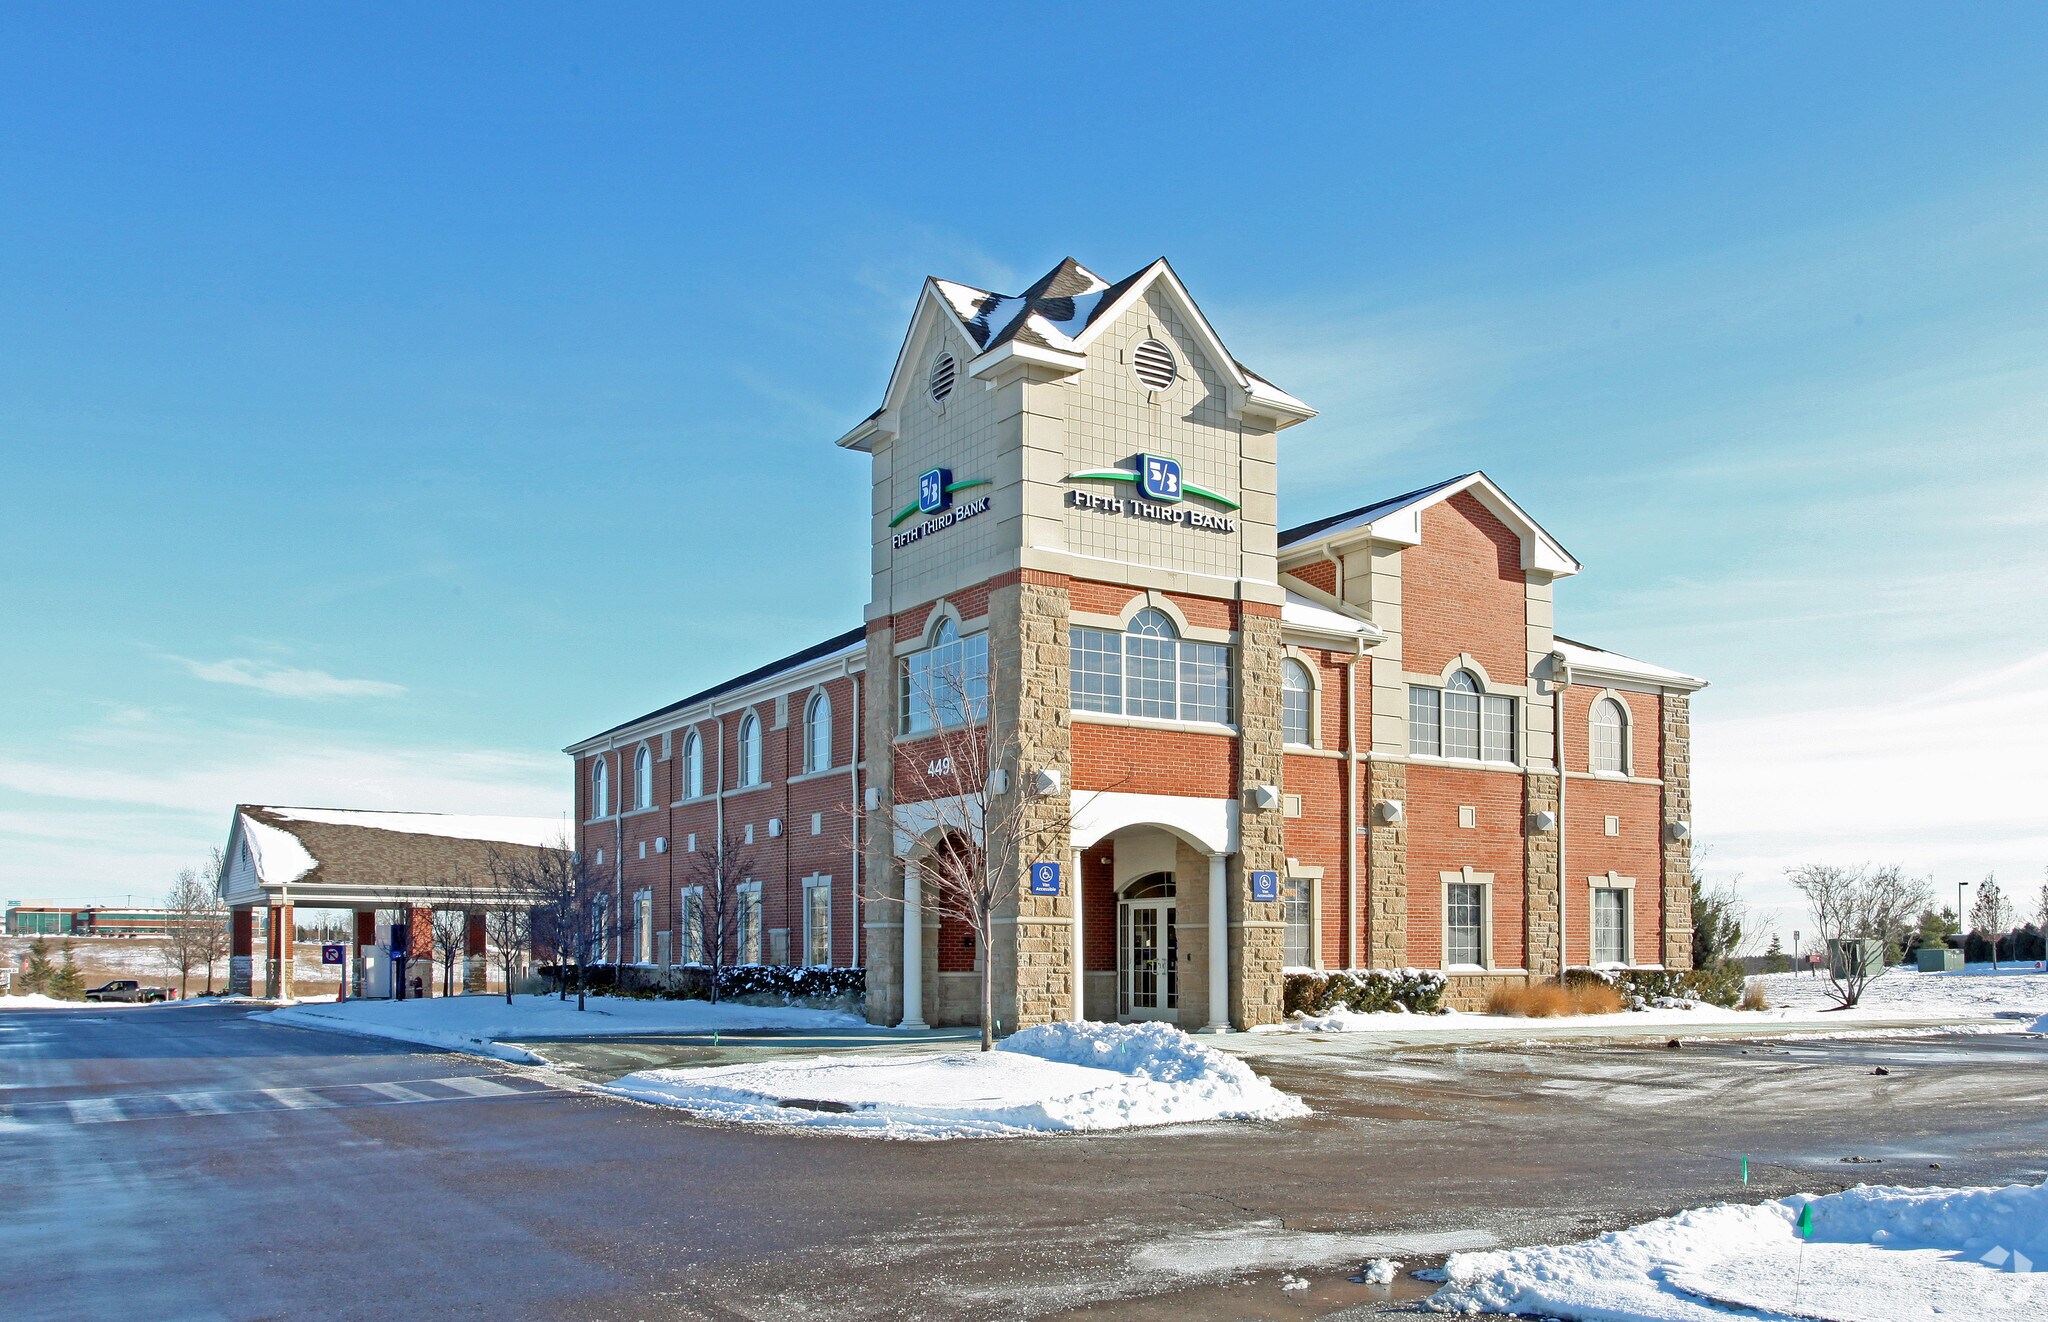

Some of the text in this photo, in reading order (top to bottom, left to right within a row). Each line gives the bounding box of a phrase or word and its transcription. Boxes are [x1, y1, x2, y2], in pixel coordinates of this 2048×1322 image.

[892, 496, 987, 549] FIFTH THIRD BANK
[1073, 489, 1237, 532] FIFTH THIRD BANK
